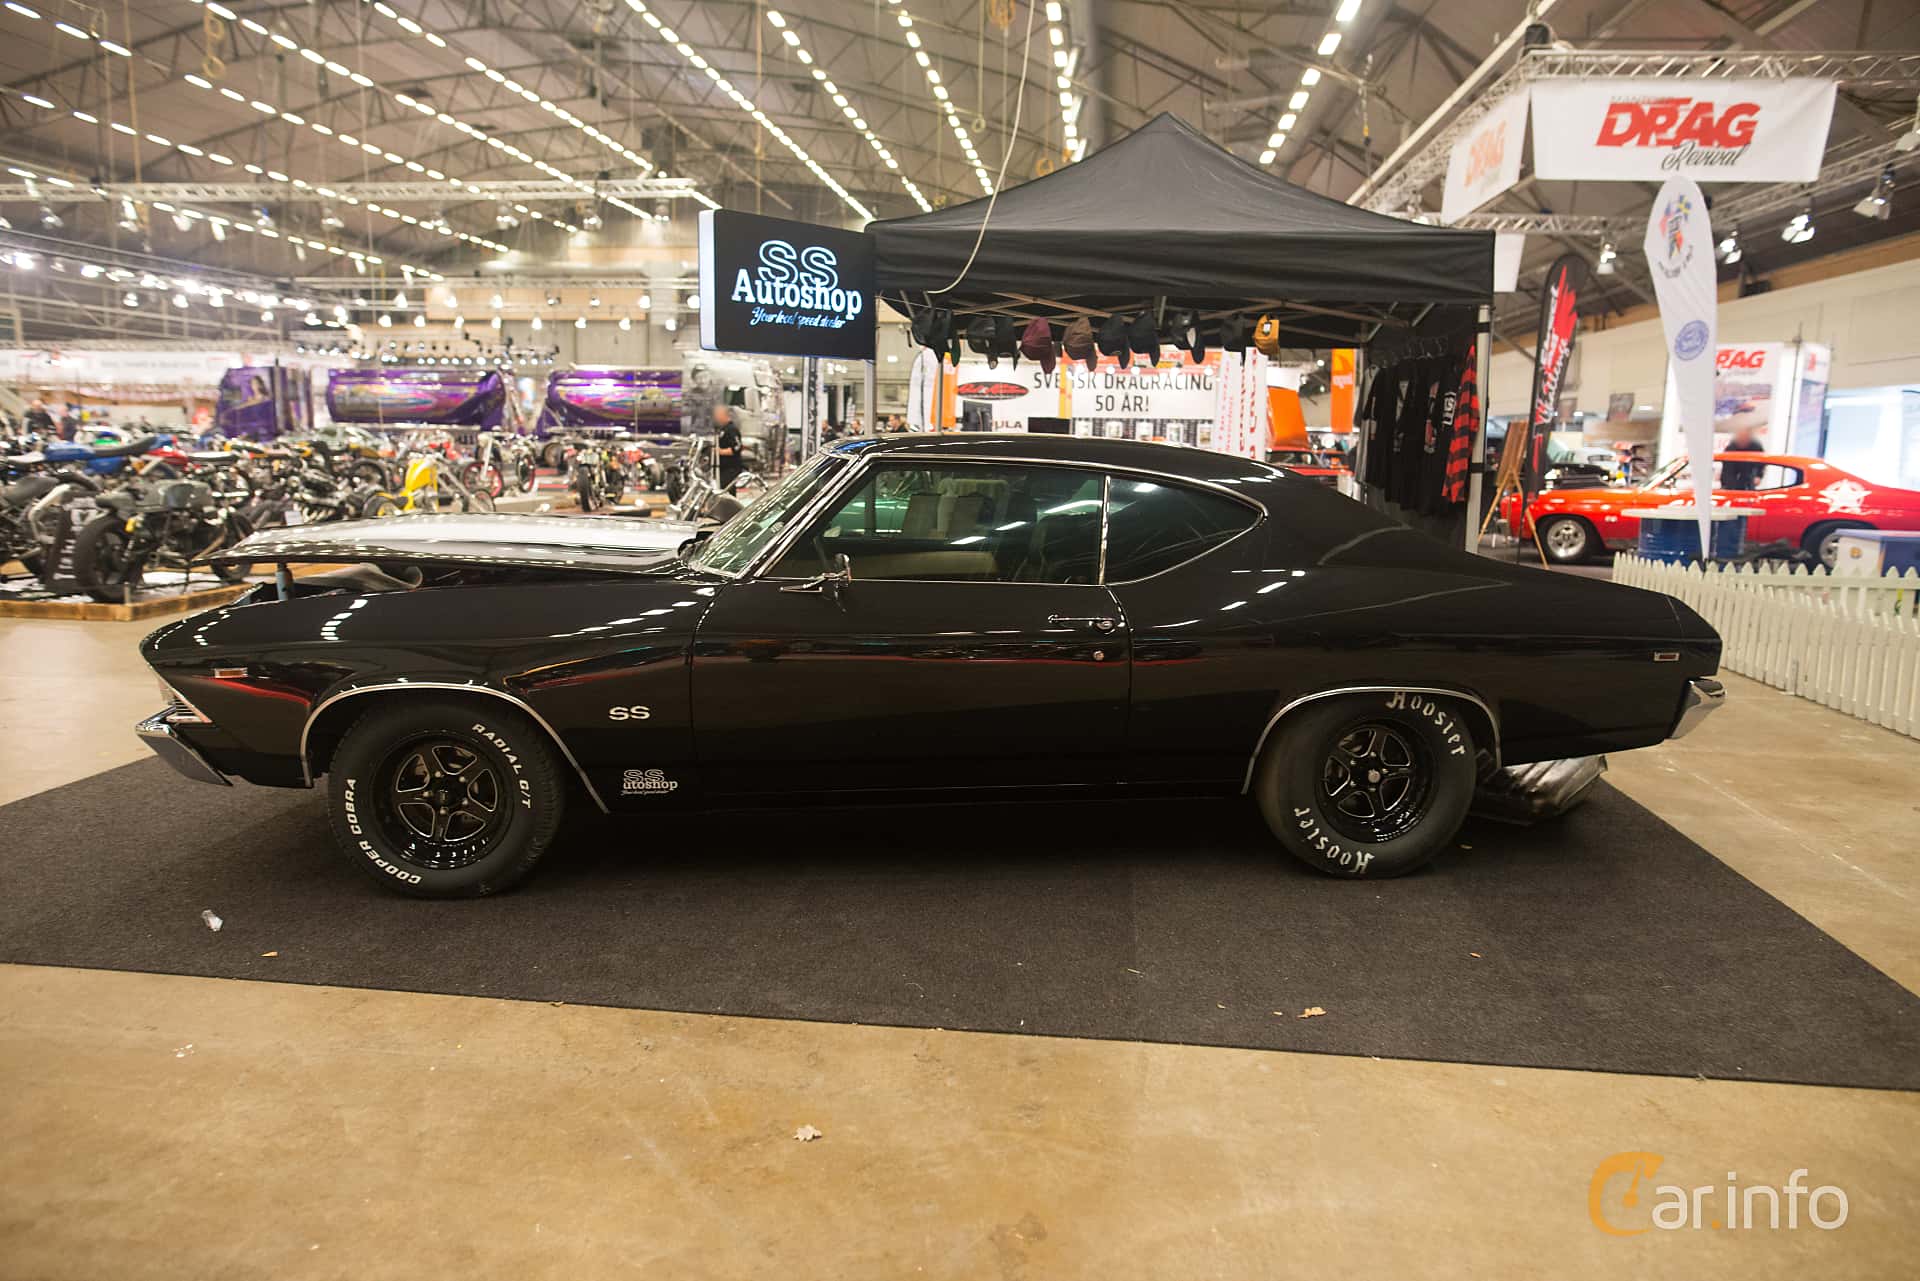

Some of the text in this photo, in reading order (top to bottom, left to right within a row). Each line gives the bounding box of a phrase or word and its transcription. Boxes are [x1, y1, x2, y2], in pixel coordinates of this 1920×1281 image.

[1595, 97, 1761, 148] DRAG
[1661, 141, 1750, 171] Revival
[757, 239, 839, 292] SS
[731, 268, 863, 321] Autoshop
[1104, 373, 1213, 391] DRAGRACING
[1715, 349, 1766, 368] RAG
[1095, 395, 1115, 412] 50
[609, 705, 651, 721] SS
[1385, 691, 1466, 756] Hoosier
[472, 723, 532, 809] RADIAL G/T
[623, 768, 665, 783] SS
[344, 778, 424, 885] COOPER COBRA
[1293, 806, 1375, 874] Hoosier
